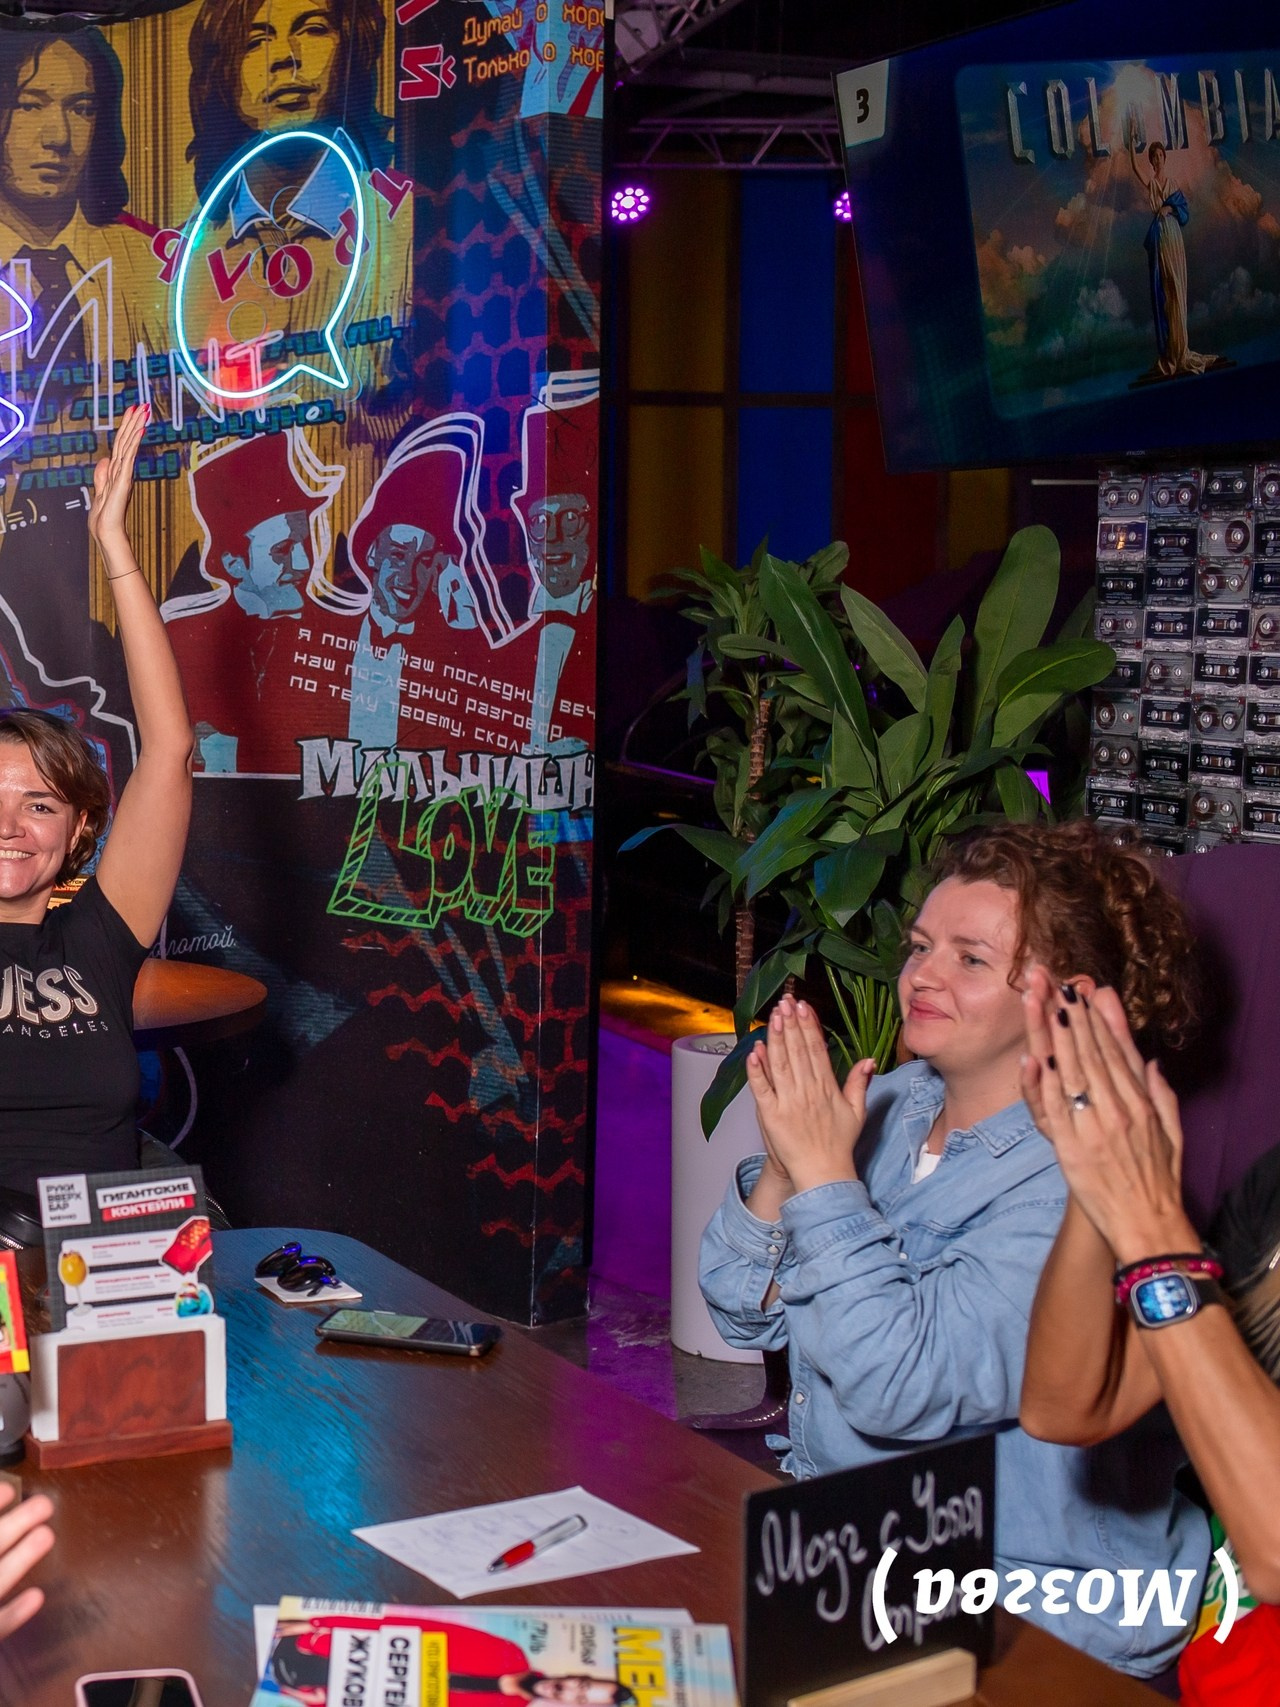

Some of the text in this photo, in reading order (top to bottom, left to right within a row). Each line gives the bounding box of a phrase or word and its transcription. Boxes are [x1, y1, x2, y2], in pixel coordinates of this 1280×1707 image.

[463, 10, 523, 46] Думай
[463, 49, 531, 83] Только
[856, 88, 870, 124] 3
[108, 400, 347, 447] етрудно,
[290, 675, 317, 692] по
[294, 652, 336, 671] наш
[345, 663, 459, 706] последний
[298, 628, 311, 641] Я
[322, 633, 387, 660] помню
[398, 648, 435, 673] наш
[443, 665, 552, 707] последний
[327, 760, 558, 937] LOVE
[2, 1020, 109, 1039] ANGELES
[102, 1182, 190, 1203] ГИГАНТСКИЕ
[111, 1197, 185, 1218] КОКТЕЙЛИ
[384, 1636, 411, 1707] СЕРГЕ
